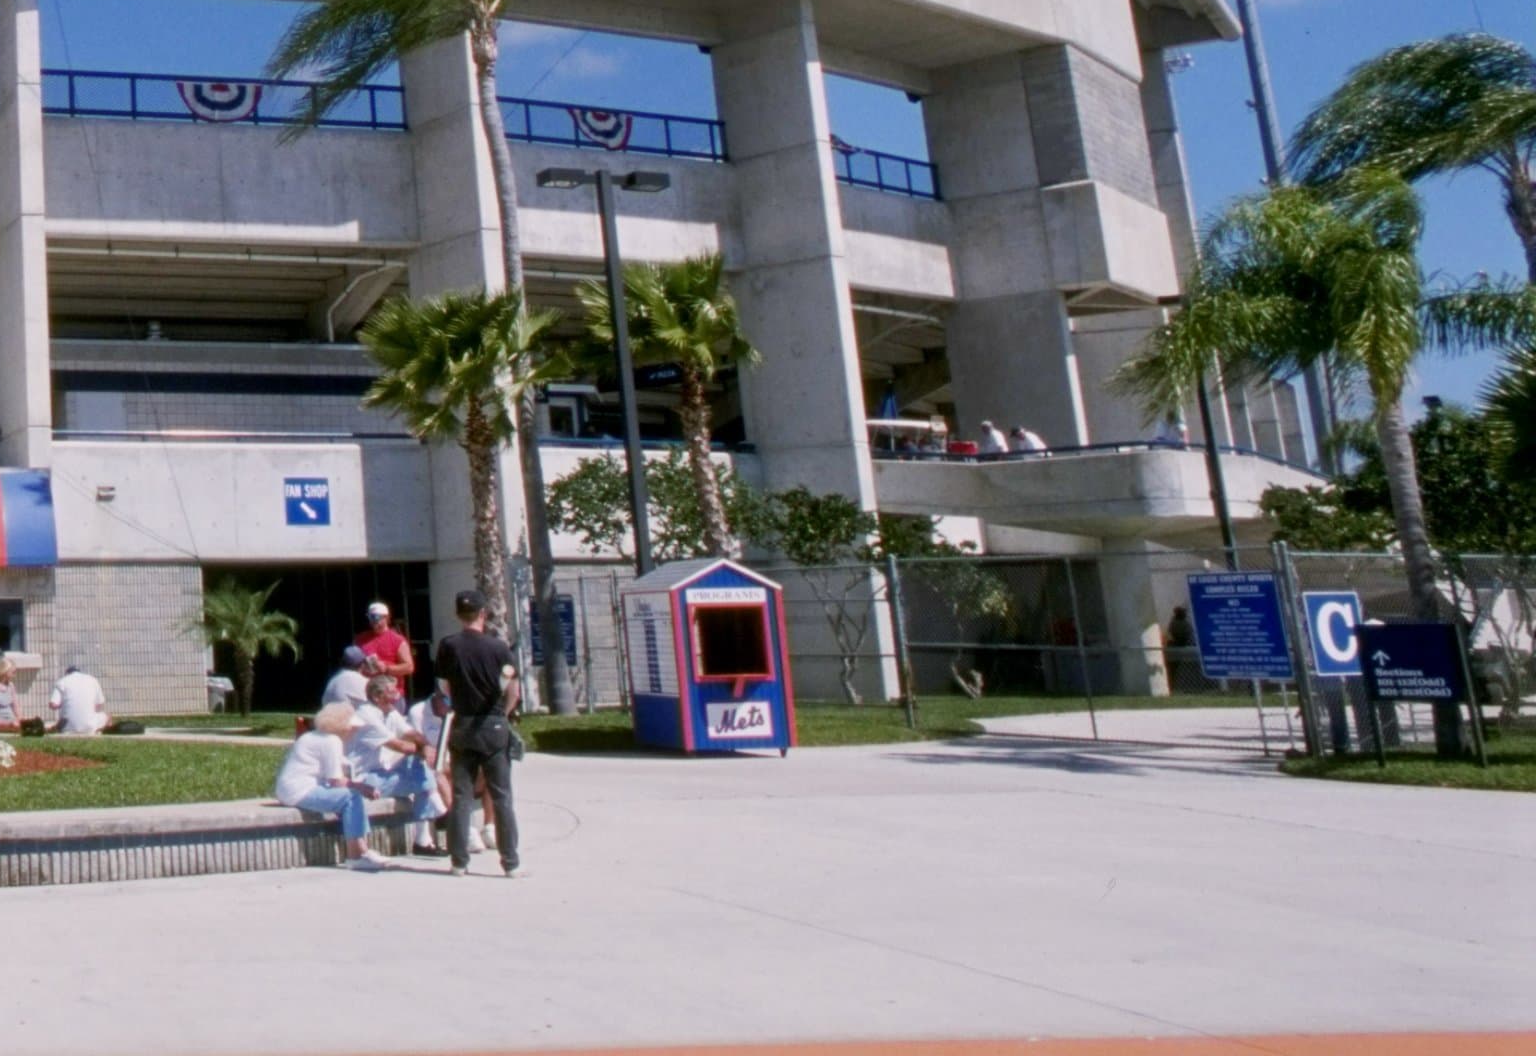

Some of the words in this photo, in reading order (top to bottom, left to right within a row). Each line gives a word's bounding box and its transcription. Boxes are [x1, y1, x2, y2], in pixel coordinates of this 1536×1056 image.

[285, 484, 302, 498] FAN
[304, 484, 328, 498] SHOP
[692, 590, 761, 600] PROGRAMS
[1317, 601, 1358, 662] C
[1375, 668, 1424, 677] Sections
[715, 706, 764, 733] Mets
